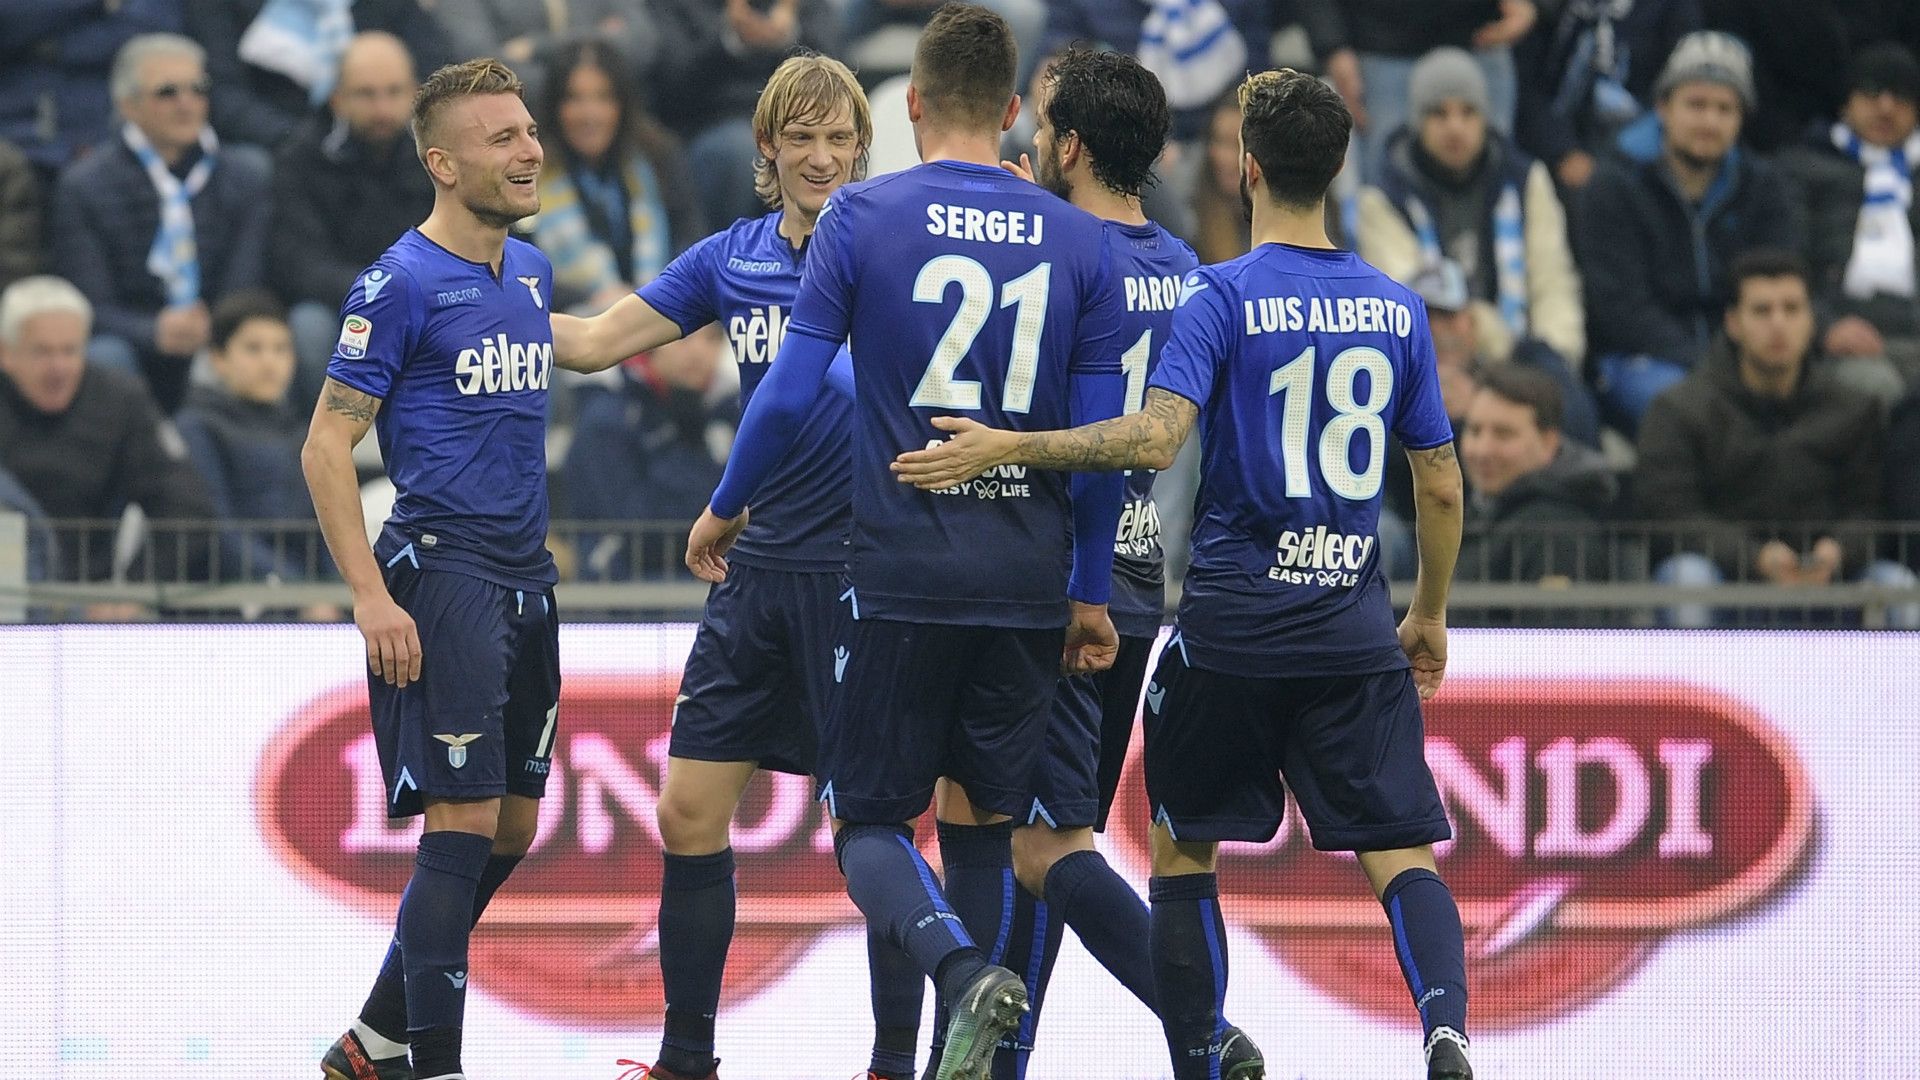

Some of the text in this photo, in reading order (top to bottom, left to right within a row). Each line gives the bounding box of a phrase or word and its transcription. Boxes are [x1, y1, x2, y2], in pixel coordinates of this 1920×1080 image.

[926, 203, 1043, 246] SERGEJ
[727, 257, 782, 273] macron
[437, 286, 482, 306] macron
[1244, 297, 1412, 338] LUIS ALBERTO
[908, 254, 1051, 414] 21
[1268, 345, 1394, 501] 18
[1001, 483, 1031, 498] LIFE
[1268, 566, 1315, 585] EASY
[1416, 987, 1446, 1011] azio
